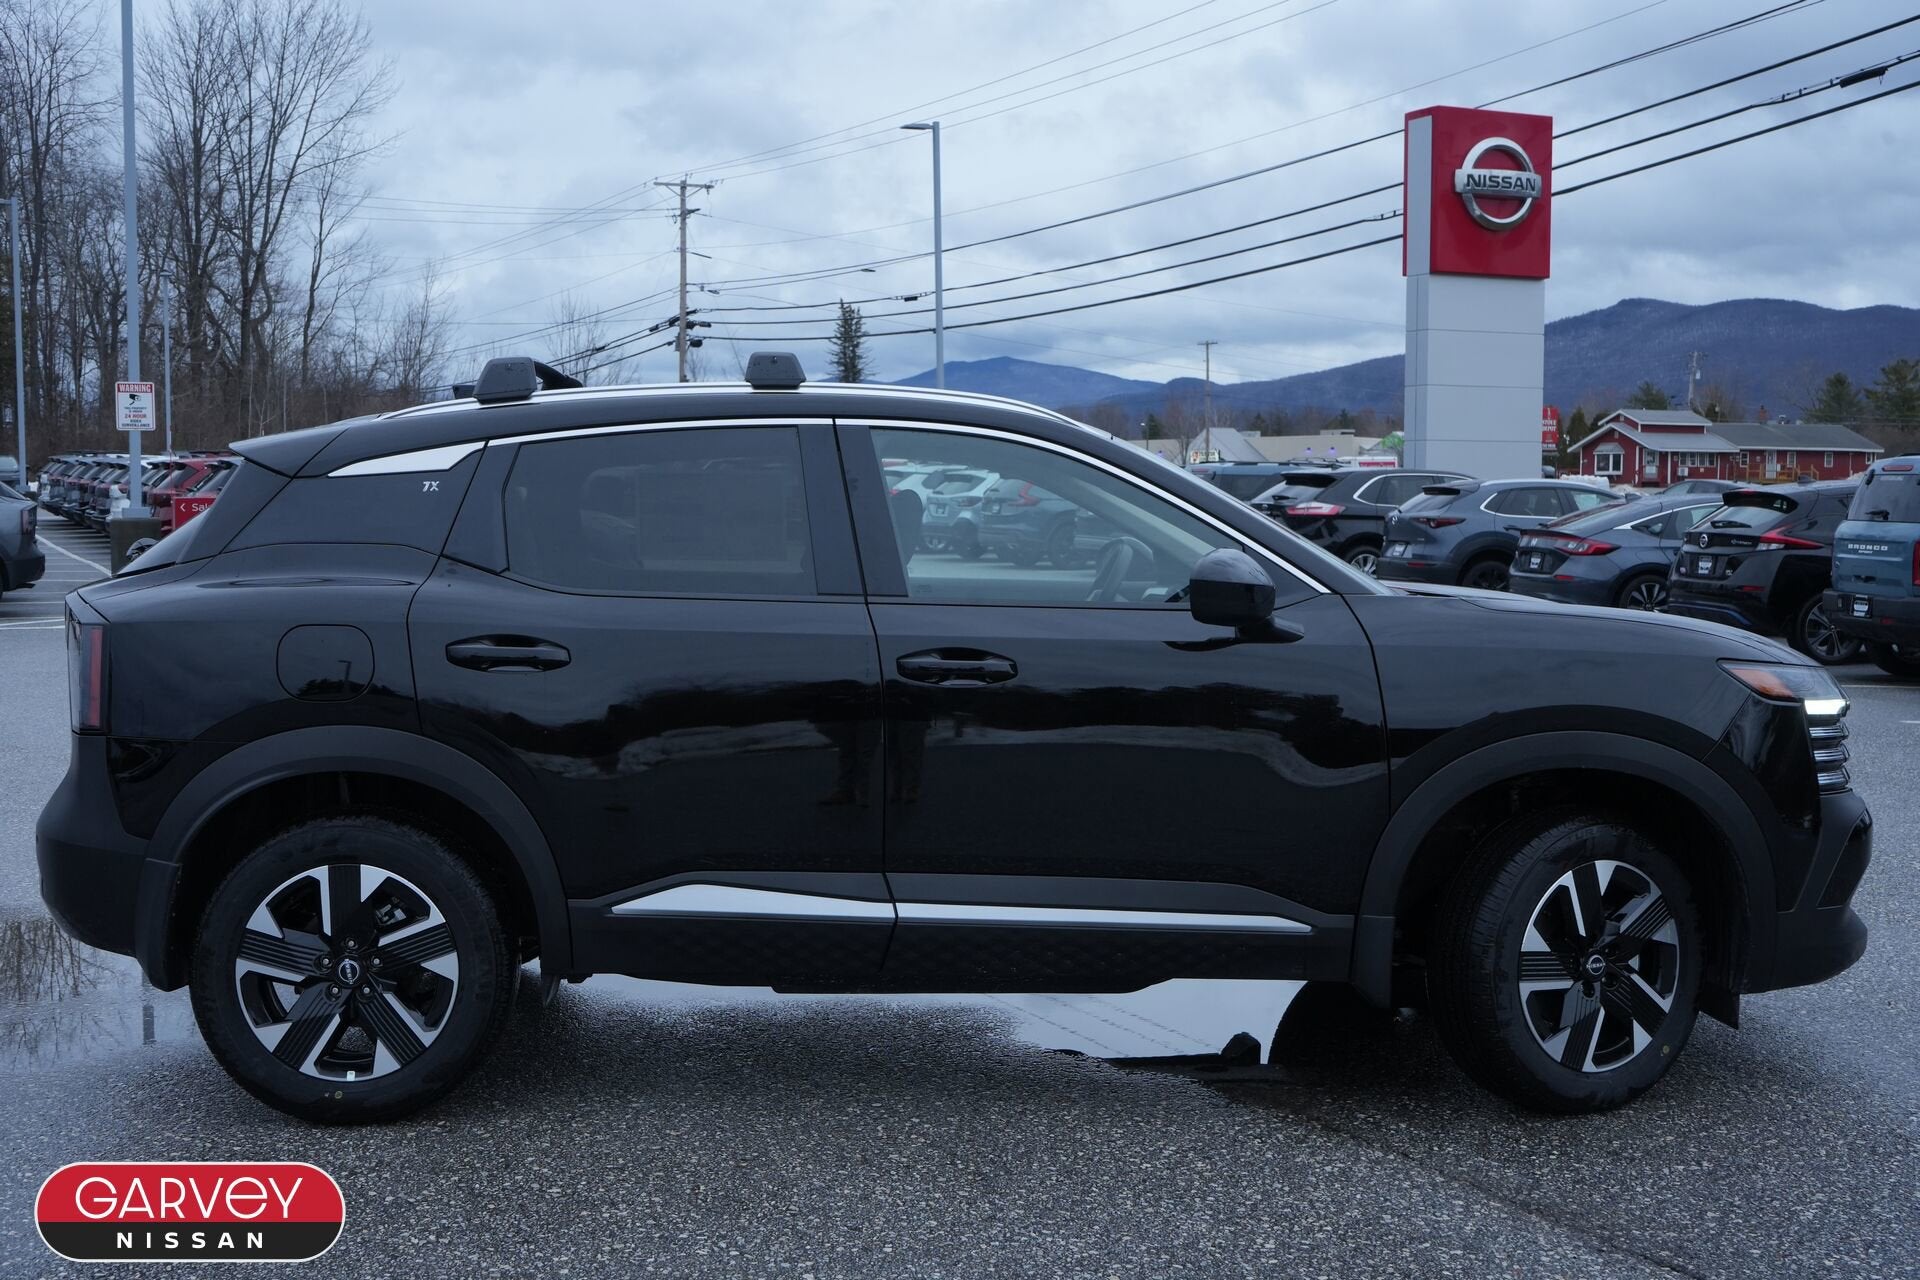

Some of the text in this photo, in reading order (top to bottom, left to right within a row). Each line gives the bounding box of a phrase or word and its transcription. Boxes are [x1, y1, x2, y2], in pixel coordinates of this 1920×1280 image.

[1466, 173, 1536, 192] NISSAN
[119, 383, 152, 393] WARNING
[1848, 543, 1888, 551] BRONCO
